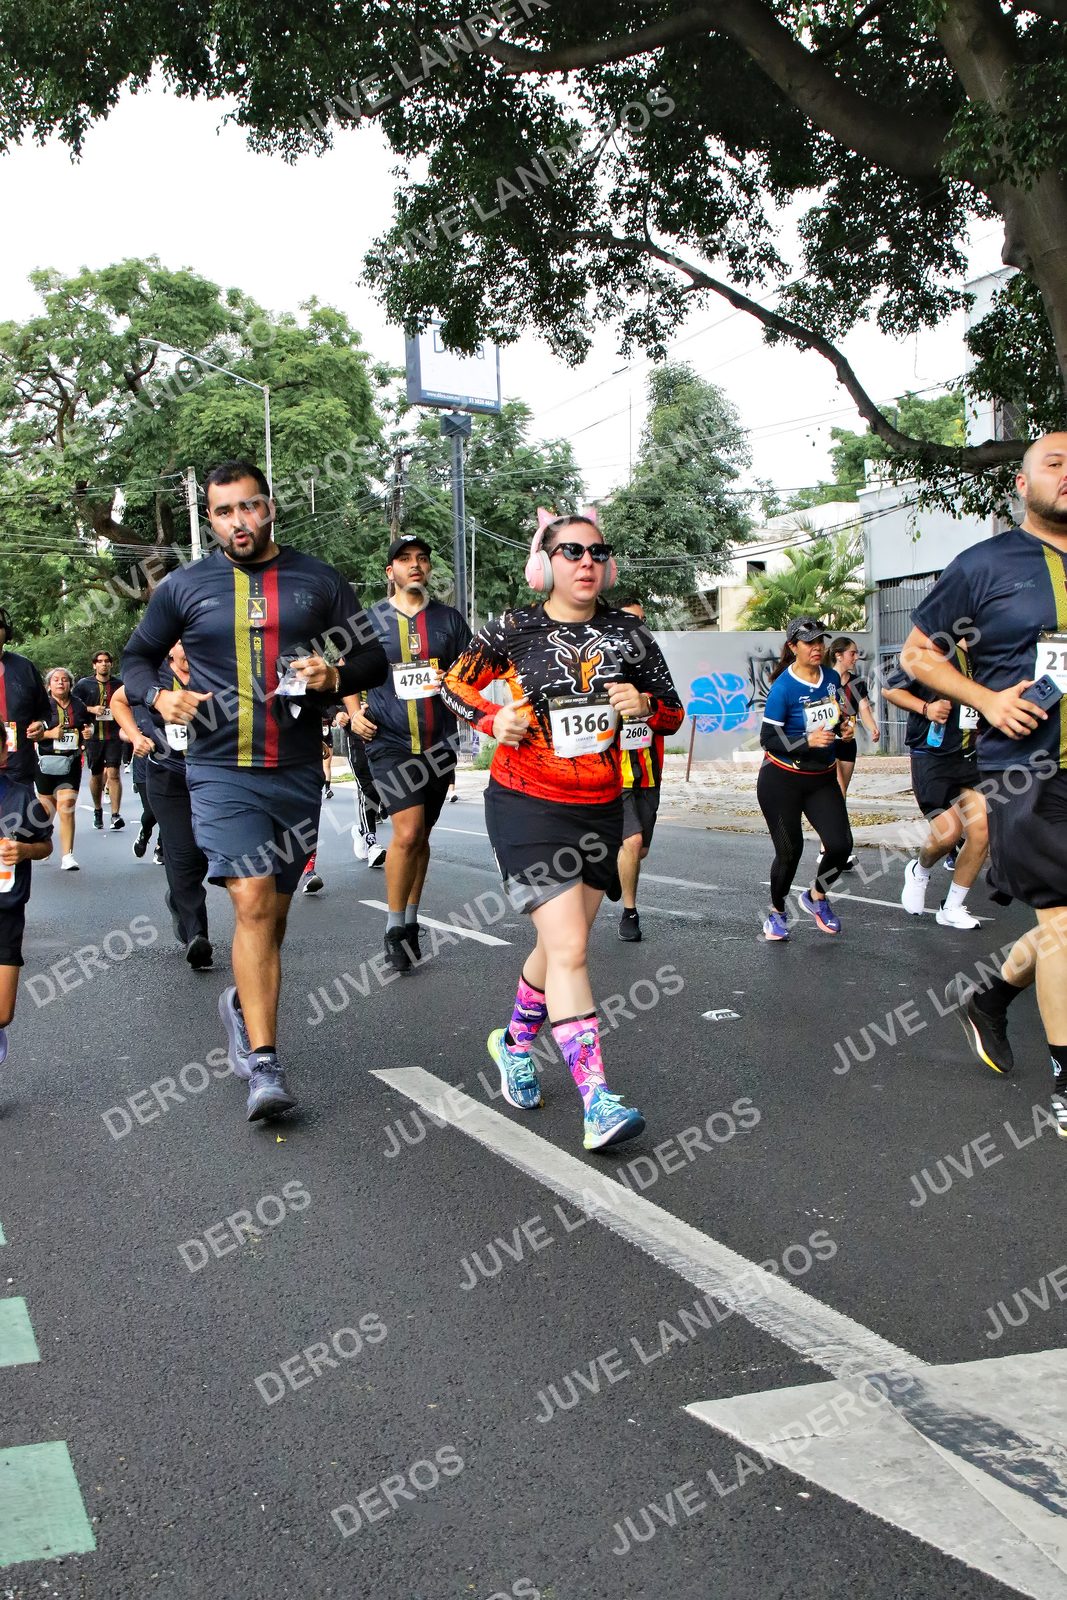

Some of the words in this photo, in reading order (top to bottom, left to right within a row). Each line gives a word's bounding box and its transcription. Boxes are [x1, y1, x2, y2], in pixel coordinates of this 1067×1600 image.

[400, 672, 431, 687] 4784
[811, 707, 834, 722] 2610
[965, 708, 980, 718] 23
[560, 712, 610, 737] 1366
[626, 726, 648, 739] 2606
